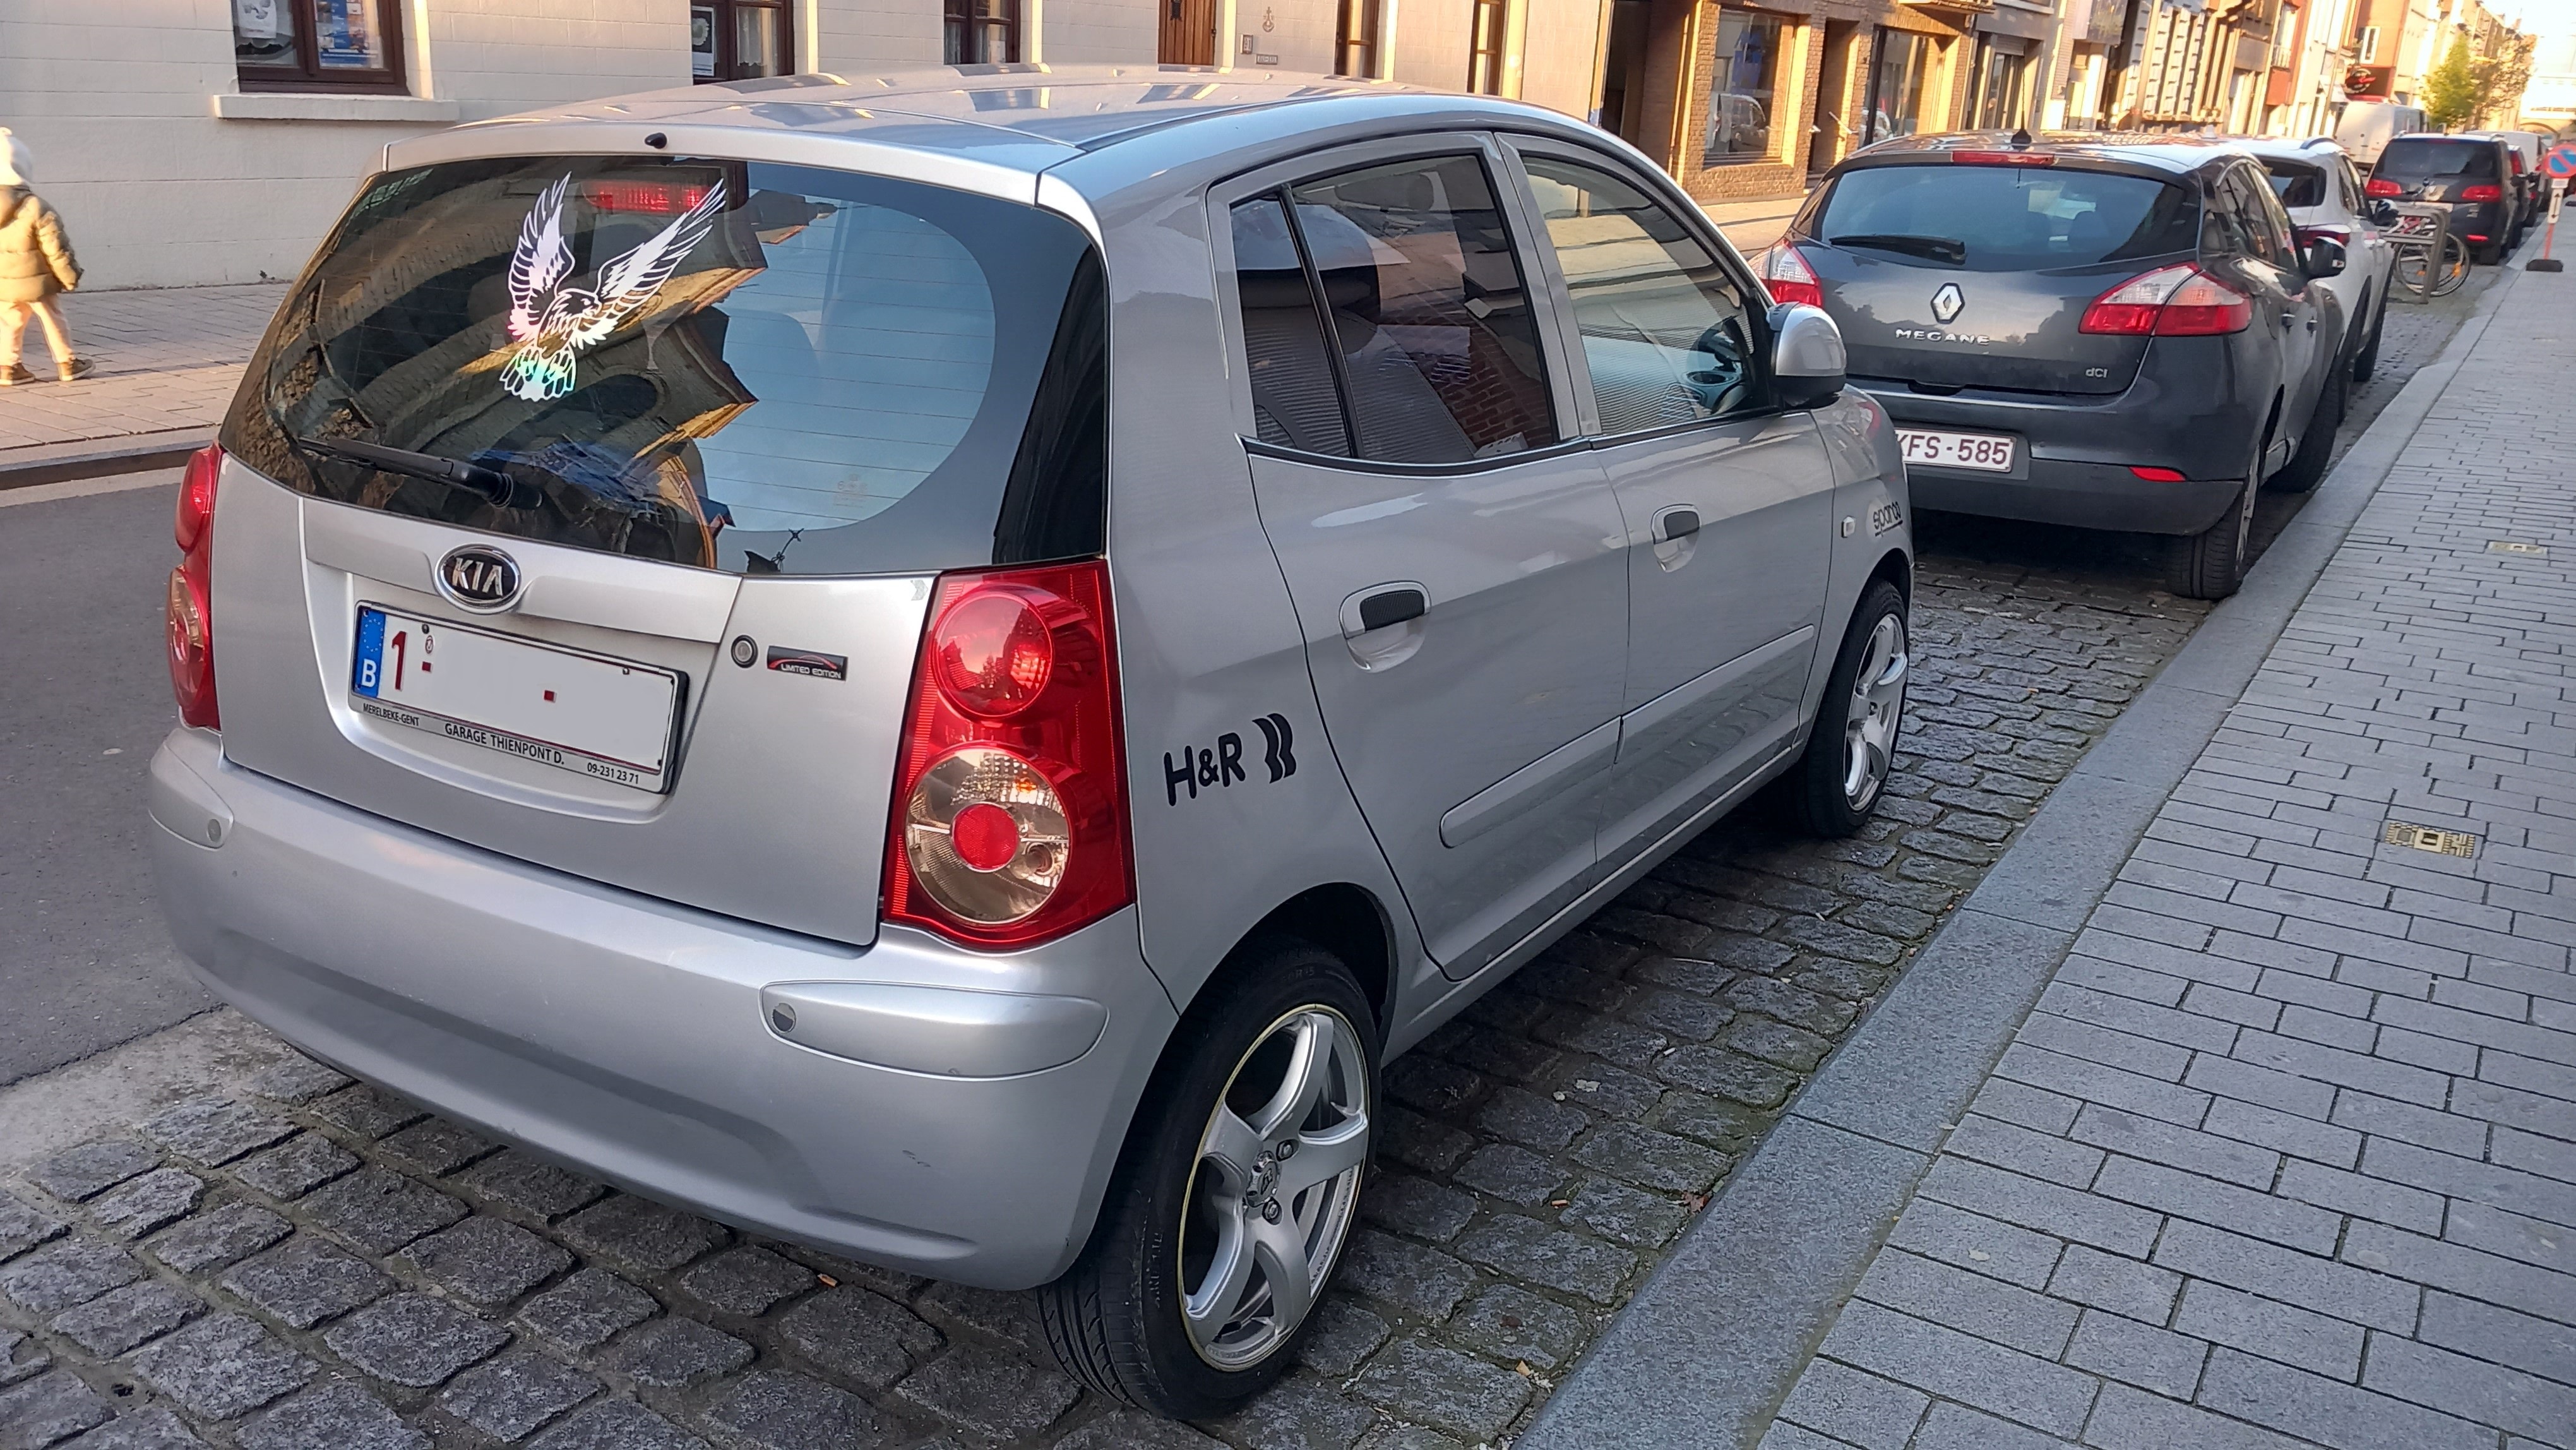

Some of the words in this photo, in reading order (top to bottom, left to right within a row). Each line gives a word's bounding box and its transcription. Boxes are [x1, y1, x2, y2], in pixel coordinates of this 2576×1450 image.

[1895, 329, 1990, 346] MEGANE
[452, 557, 504, 596] KIA
[361, 658, 377, 688] B
[781, 664, 810, 674] LIMITED
[812, 668, 842, 679] EDITION
[363, 703, 420, 726] MERELBEKE-GENT
[444, 723, 487, 745] GARAGE
[490, 734, 552, 761] THIENPONT
[554, 751, 565, 765] D.
[587, 762, 614, 778] 09-231
[616, 770, 628, 782] 23
[629, 773, 639, 784] 71
[1164, 732, 1246, 807] H&R
